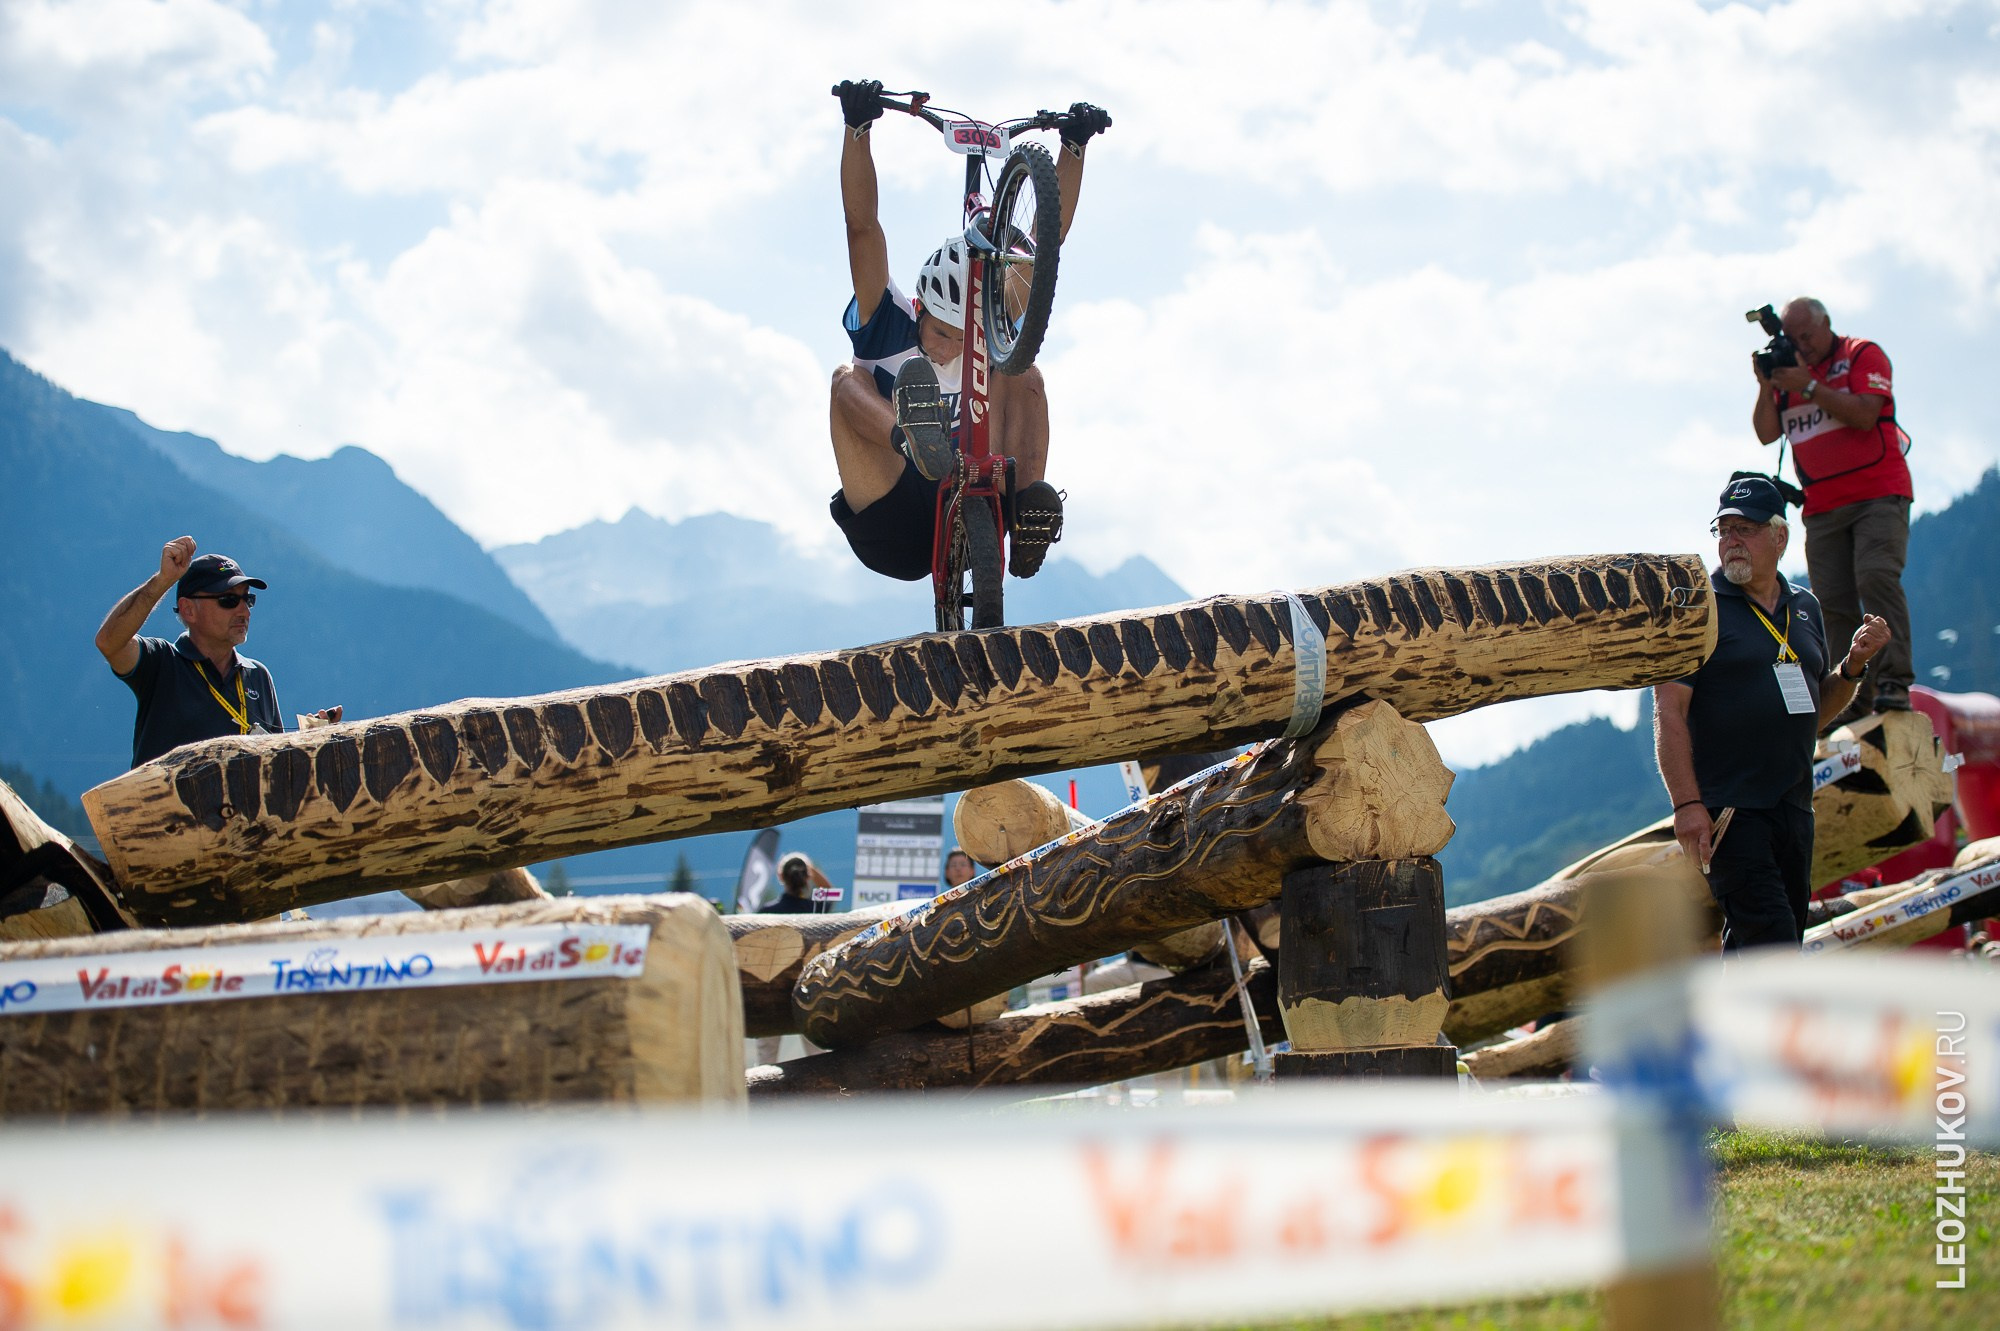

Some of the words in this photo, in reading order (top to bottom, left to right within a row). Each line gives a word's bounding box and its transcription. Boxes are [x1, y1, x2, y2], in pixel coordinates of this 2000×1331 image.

[959, 129, 998, 147] 303
[972, 277, 988, 396] CLEAN
[1901, 886, 1961, 919] TRENTINO
[77, 967, 129, 1000] Val
[160, 963, 244, 996] Sole
[270, 953, 433, 992] TRENTINO
[473, 941, 525, 975] Val
[559, 937, 644, 968] Sole
